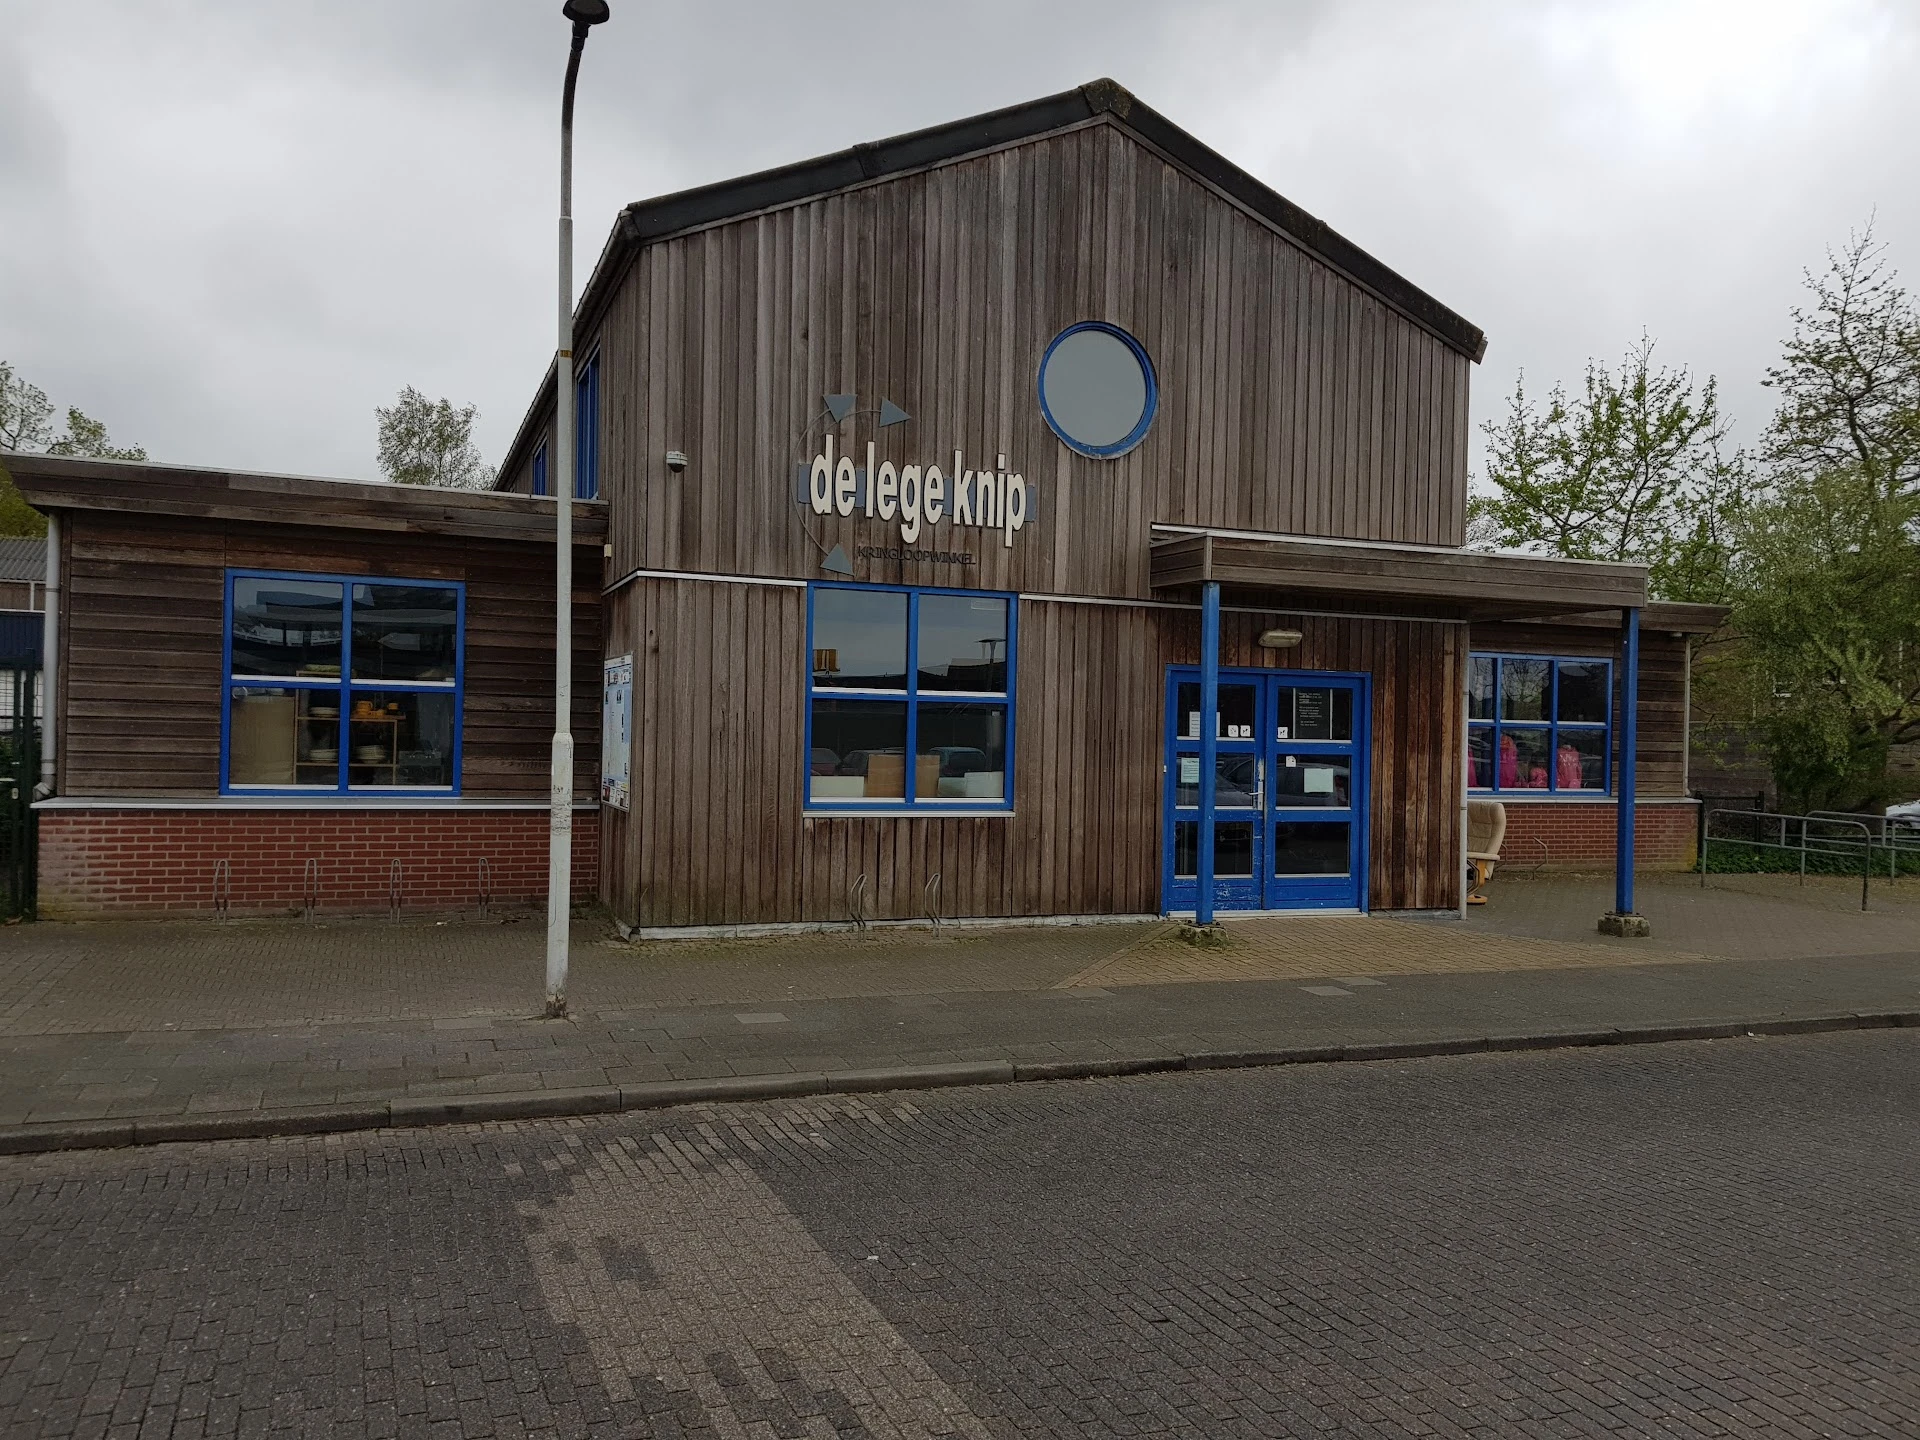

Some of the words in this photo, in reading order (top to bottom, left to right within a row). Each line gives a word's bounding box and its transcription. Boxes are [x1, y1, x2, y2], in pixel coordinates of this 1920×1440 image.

[810, 433, 857, 517] de
[865, 441, 945, 544] lege
[952, 449, 1027, 548] knip
[857, 545, 977, 566] KRINGLOOPWINKEL
